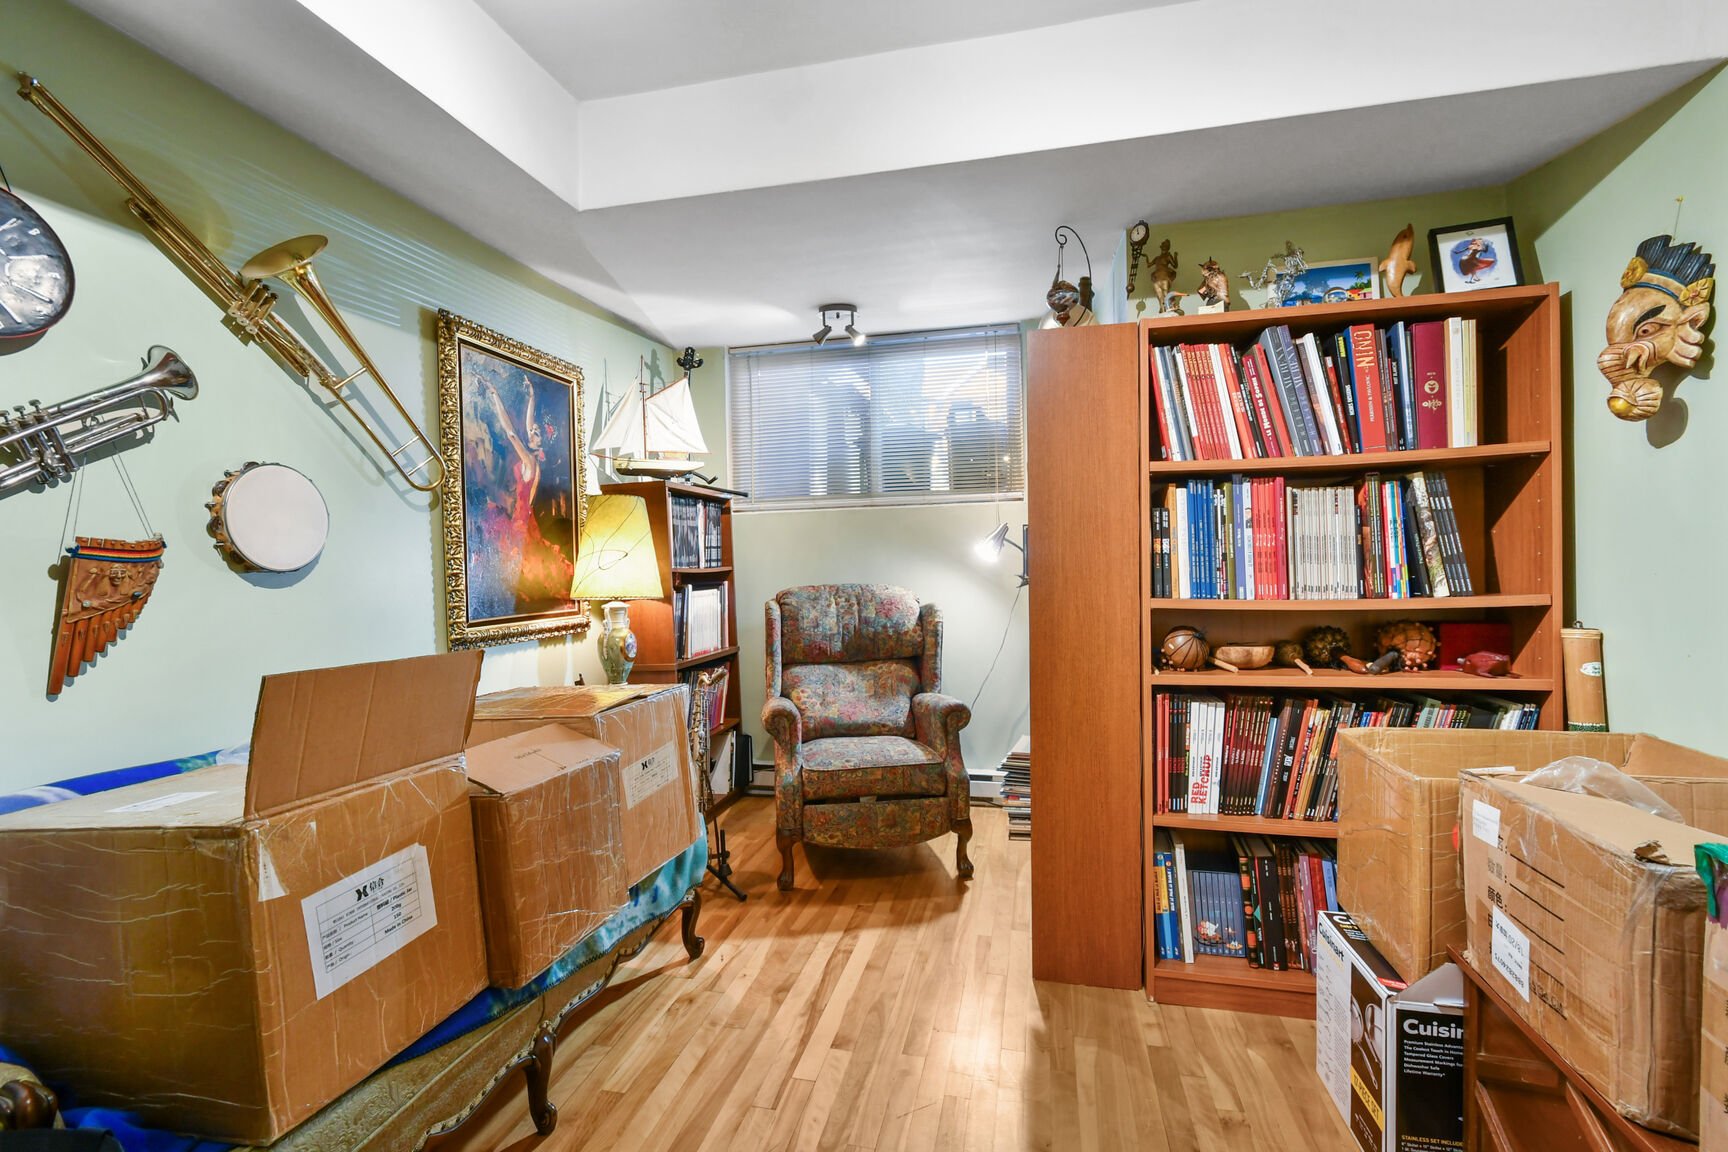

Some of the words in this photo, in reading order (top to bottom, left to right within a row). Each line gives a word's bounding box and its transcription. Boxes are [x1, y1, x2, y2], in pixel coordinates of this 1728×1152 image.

[1191, 782, 1200, 804] RED
[1198, 754, 1211, 804] KETCHUP
[1319, 922, 1344, 962] Cuisinart
